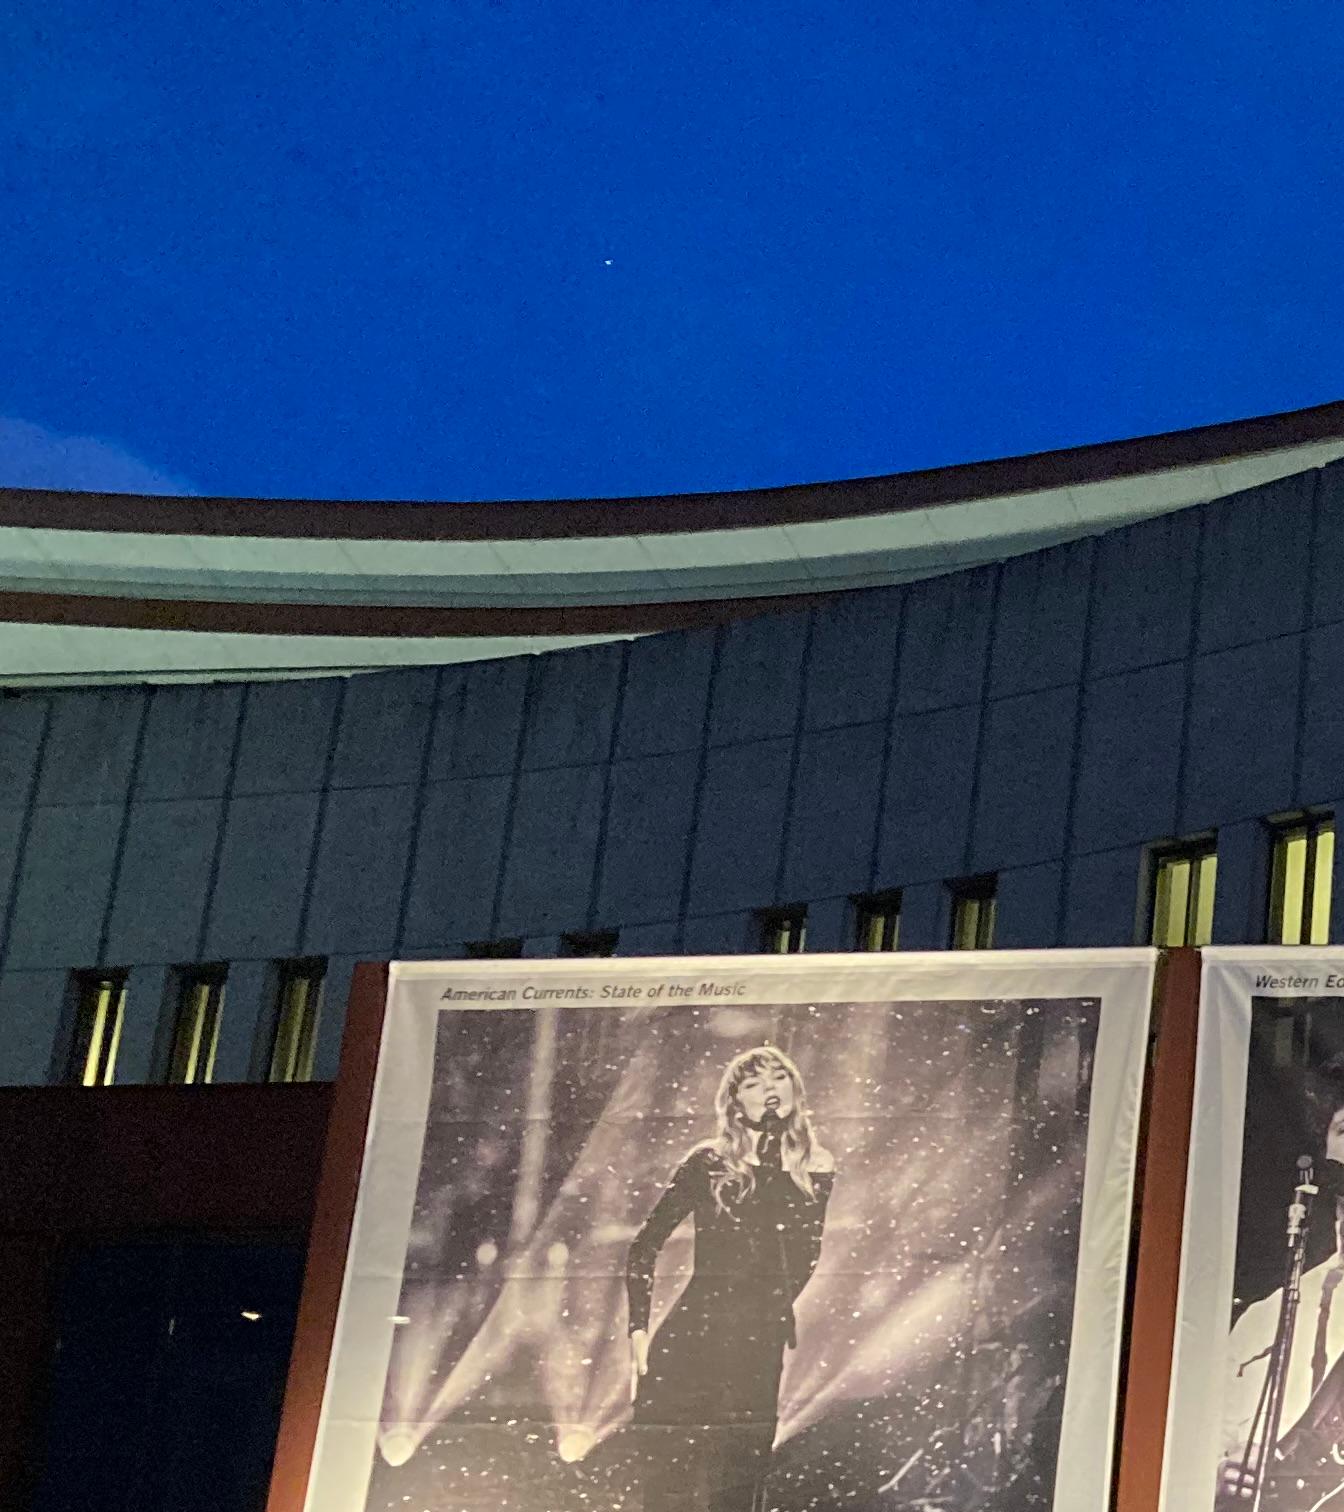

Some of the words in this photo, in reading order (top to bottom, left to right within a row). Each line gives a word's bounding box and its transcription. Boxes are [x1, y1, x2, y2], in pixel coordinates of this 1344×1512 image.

[1255, 974, 1319, 988] Western
[441, 986, 516, 1001] American
[521, 986, 595, 1000] Currents:
[599, 984, 642, 999] State
[647, 983, 666, 998] of
[669, 983, 693, 997] the
[698, 983, 746, 997] Music
